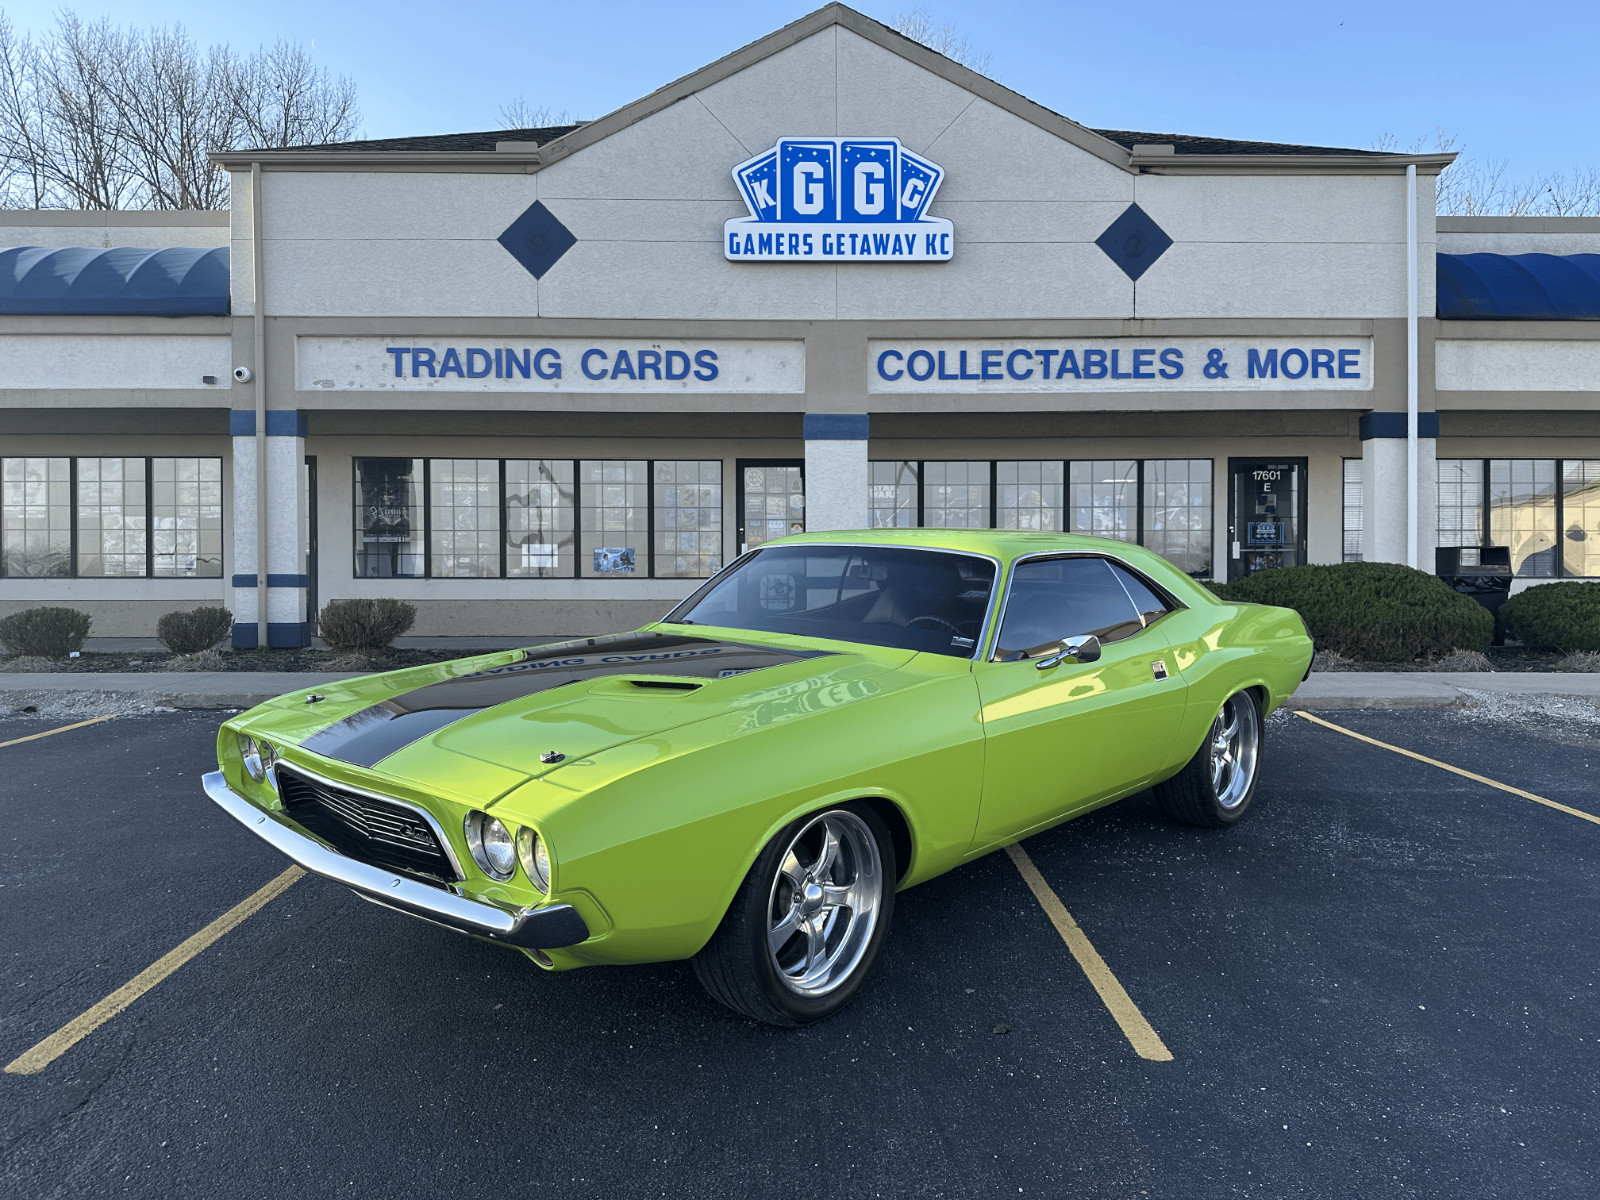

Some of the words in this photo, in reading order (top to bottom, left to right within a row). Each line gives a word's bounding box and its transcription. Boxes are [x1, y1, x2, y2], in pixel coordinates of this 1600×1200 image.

[728, 232, 813, 255] GAMERS
[822, 232, 917, 255] GETAWAY
[925, 232, 950, 255] KC
[387, 348, 561, 379] TRADING
[582, 348, 719, 381] CARDS
[878, 348, 1184, 380] COLLECTABLES
[1203, 348, 1228, 379] &
[1248, 348, 1361, 379] MORE
[1252, 470, 1281, 481] 17601
[1263, 482, 1272, 492] E
